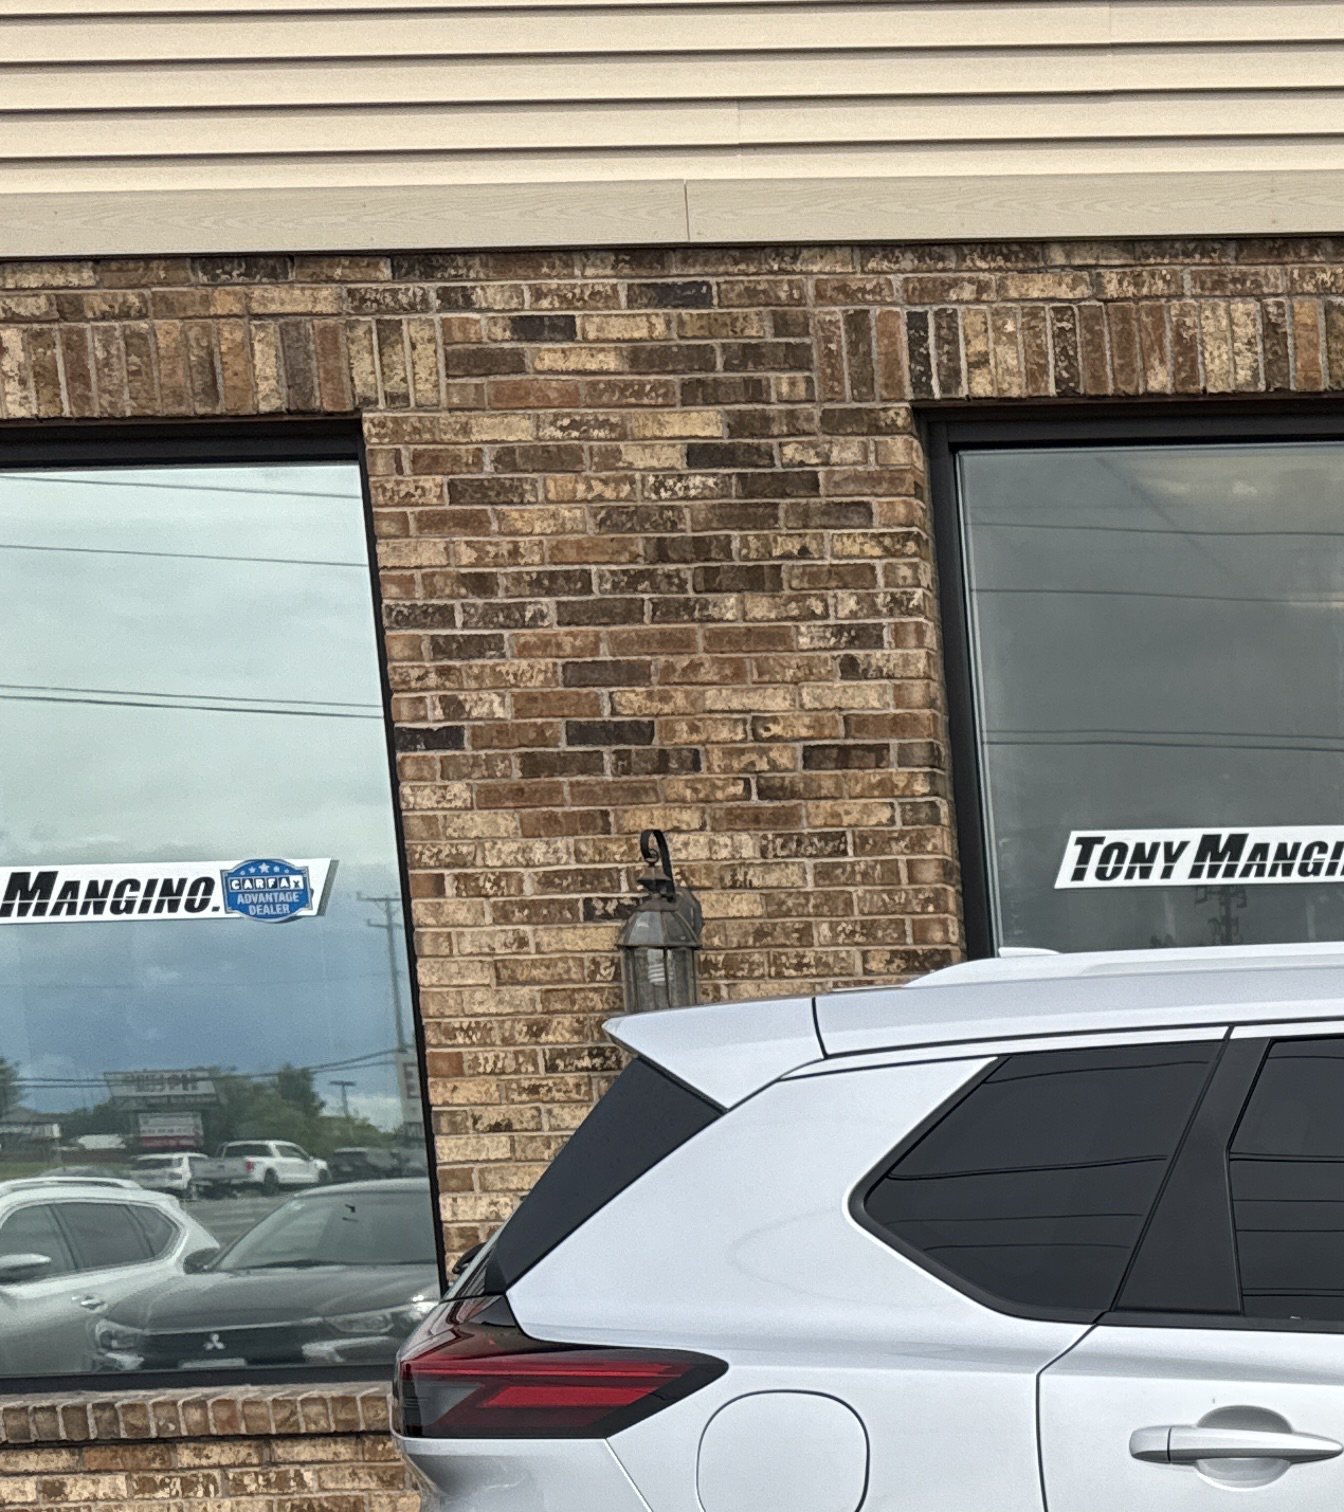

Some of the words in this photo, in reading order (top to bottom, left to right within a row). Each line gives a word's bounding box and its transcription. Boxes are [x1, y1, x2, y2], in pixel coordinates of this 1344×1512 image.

[1070, 835, 1191, 882] TONY
[230, 876, 305, 891] CARFAX
[236, 891, 301, 905] ADVANTAGE
[248, 903, 291, 916] DEALER
